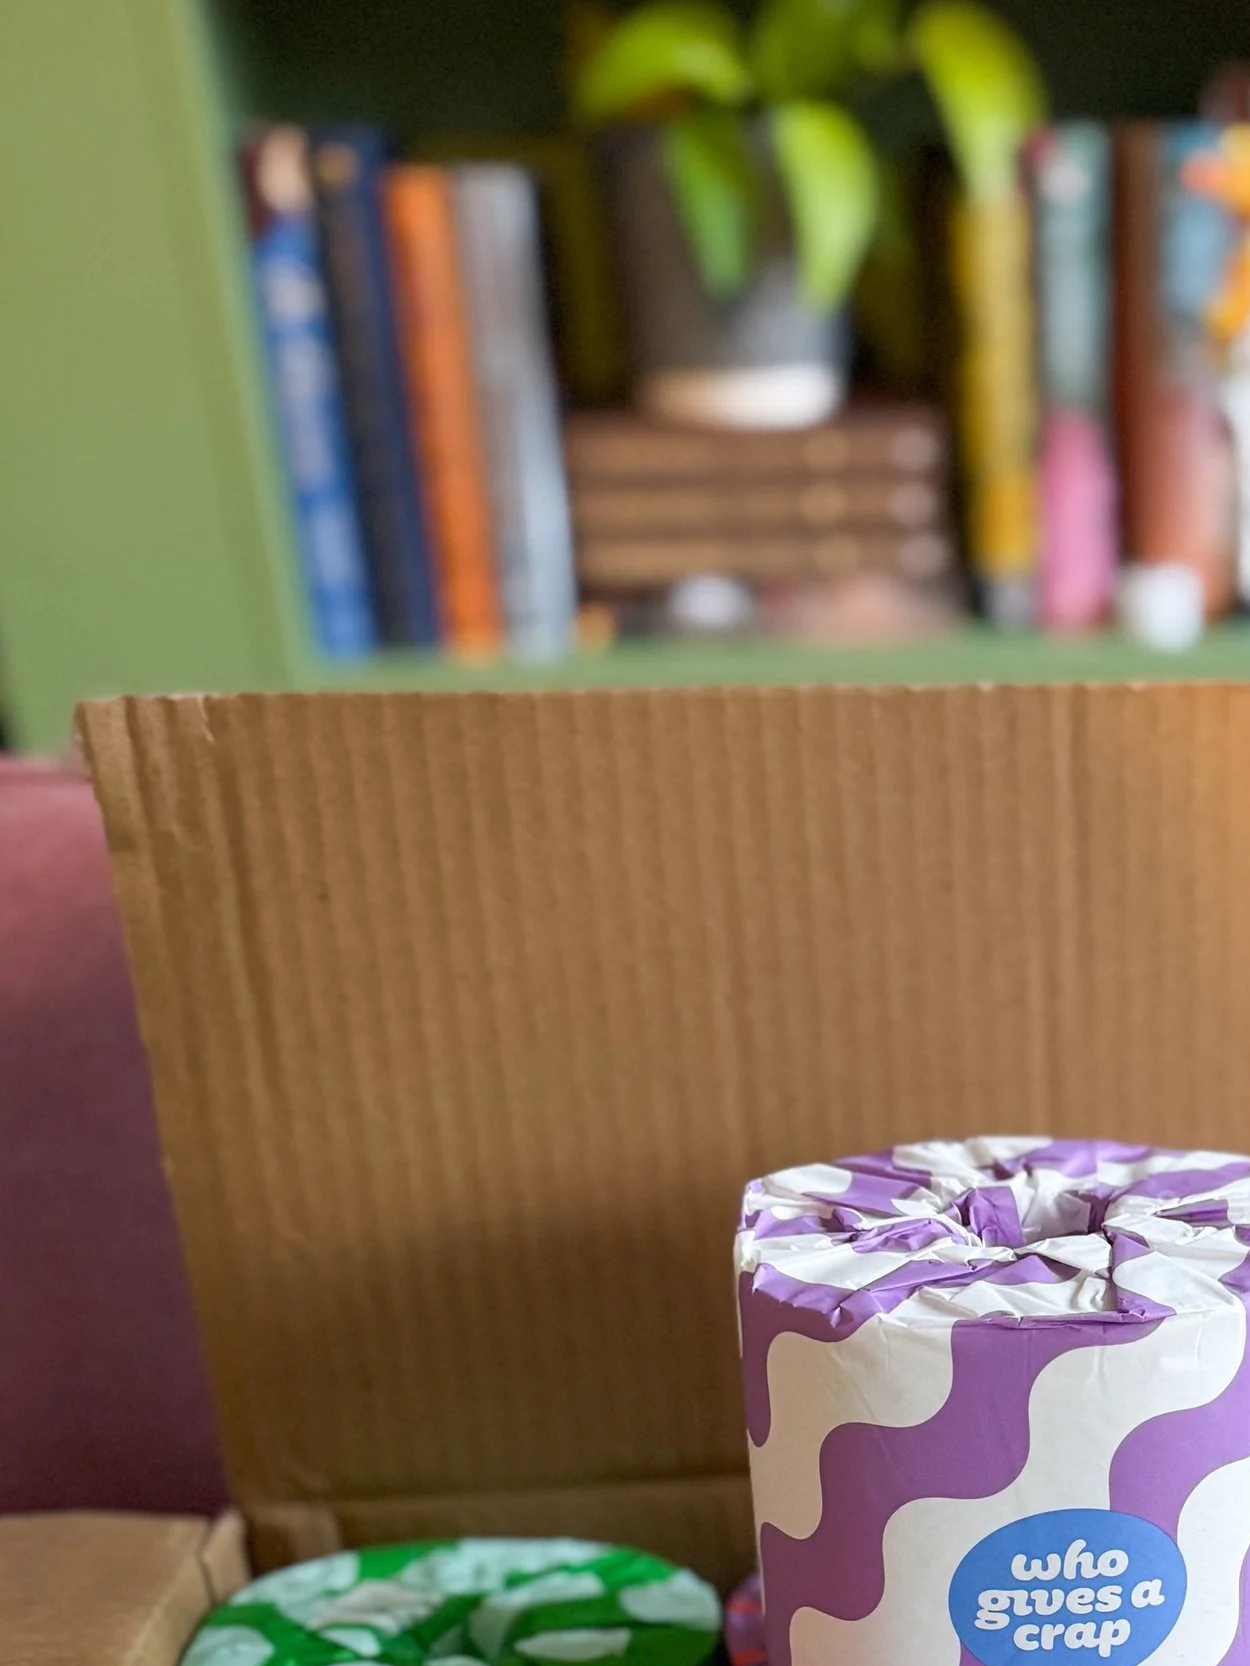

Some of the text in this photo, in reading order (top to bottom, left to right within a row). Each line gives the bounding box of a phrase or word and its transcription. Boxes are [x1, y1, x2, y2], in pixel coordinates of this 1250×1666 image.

[1011, 1539, 1129, 1581] who
[974, 1578, 1165, 1631] gives a
[1013, 1618, 1131, 1658] crap
